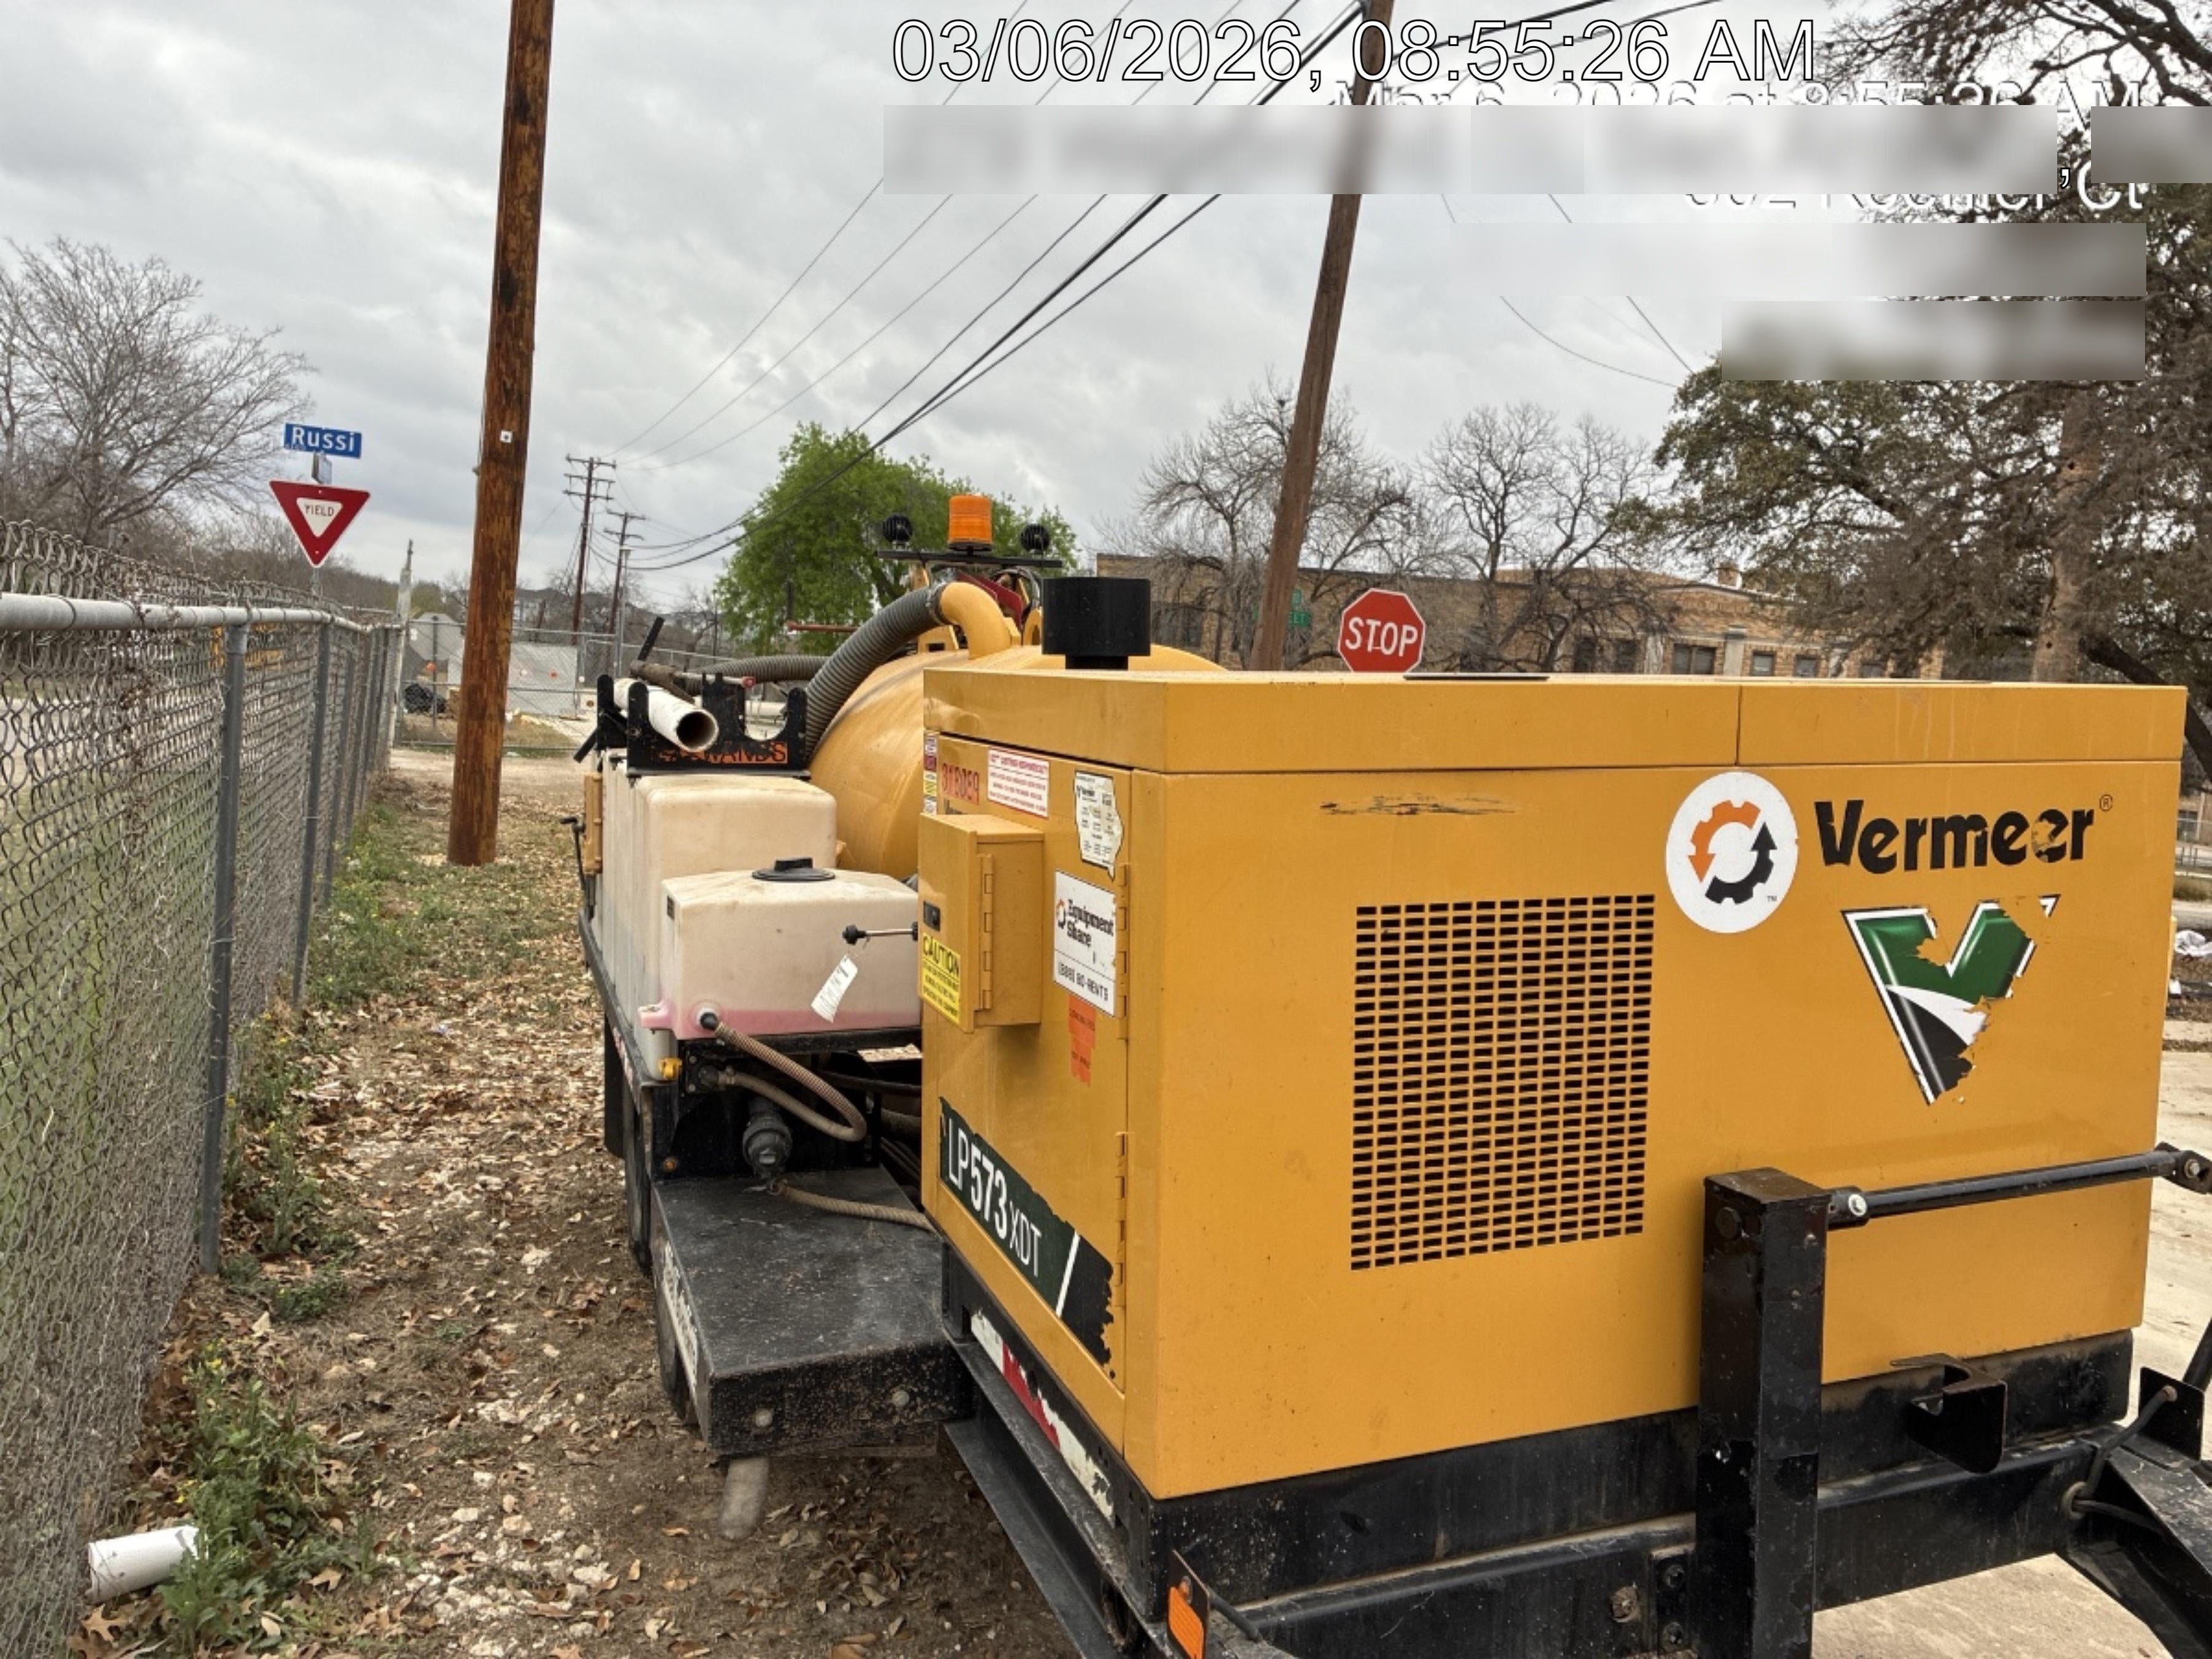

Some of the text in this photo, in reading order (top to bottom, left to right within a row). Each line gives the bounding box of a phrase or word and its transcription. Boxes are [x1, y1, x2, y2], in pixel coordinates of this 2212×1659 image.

[292, 426, 355, 452] Russi
[305, 504, 334, 517] YIELD
[1345, 616, 1419, 657] STOP
[1814, 799, 2095, 874] Vermeer
[1067, 899, 1114, 936] Equipment
[1067, 920, 1091, 947] Share
